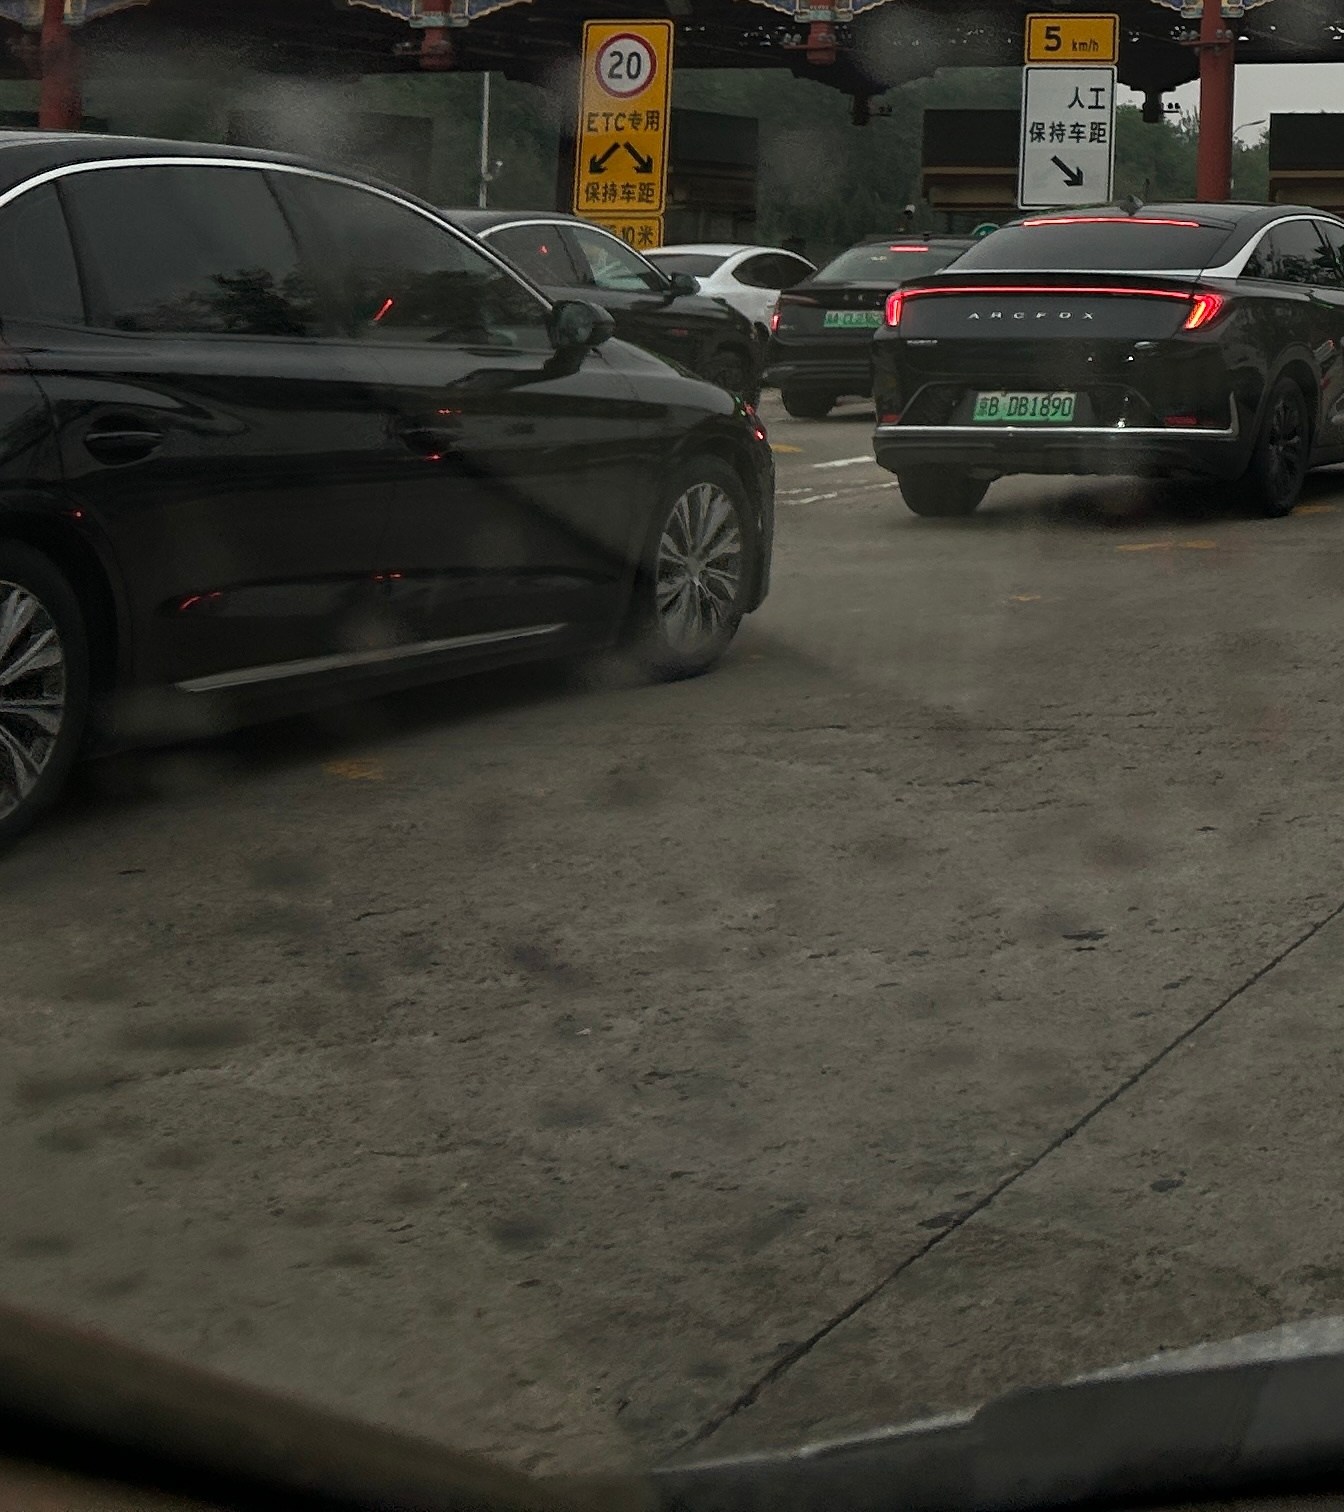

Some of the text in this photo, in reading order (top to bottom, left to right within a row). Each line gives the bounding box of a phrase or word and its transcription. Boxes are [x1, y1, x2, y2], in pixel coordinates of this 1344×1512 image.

[1044, 26, 1099, 53] 5 km/h
[607, 51, 641, 80] 20
[1068, 86, 1106, 110] 人工
[587, 109, 660, 133] ETC专用
[1028, 121, 1108, 144] 保持车距
[584, 181, 656, 204] 保持车距
[968, 311, 1095, 320] ARCFOX
